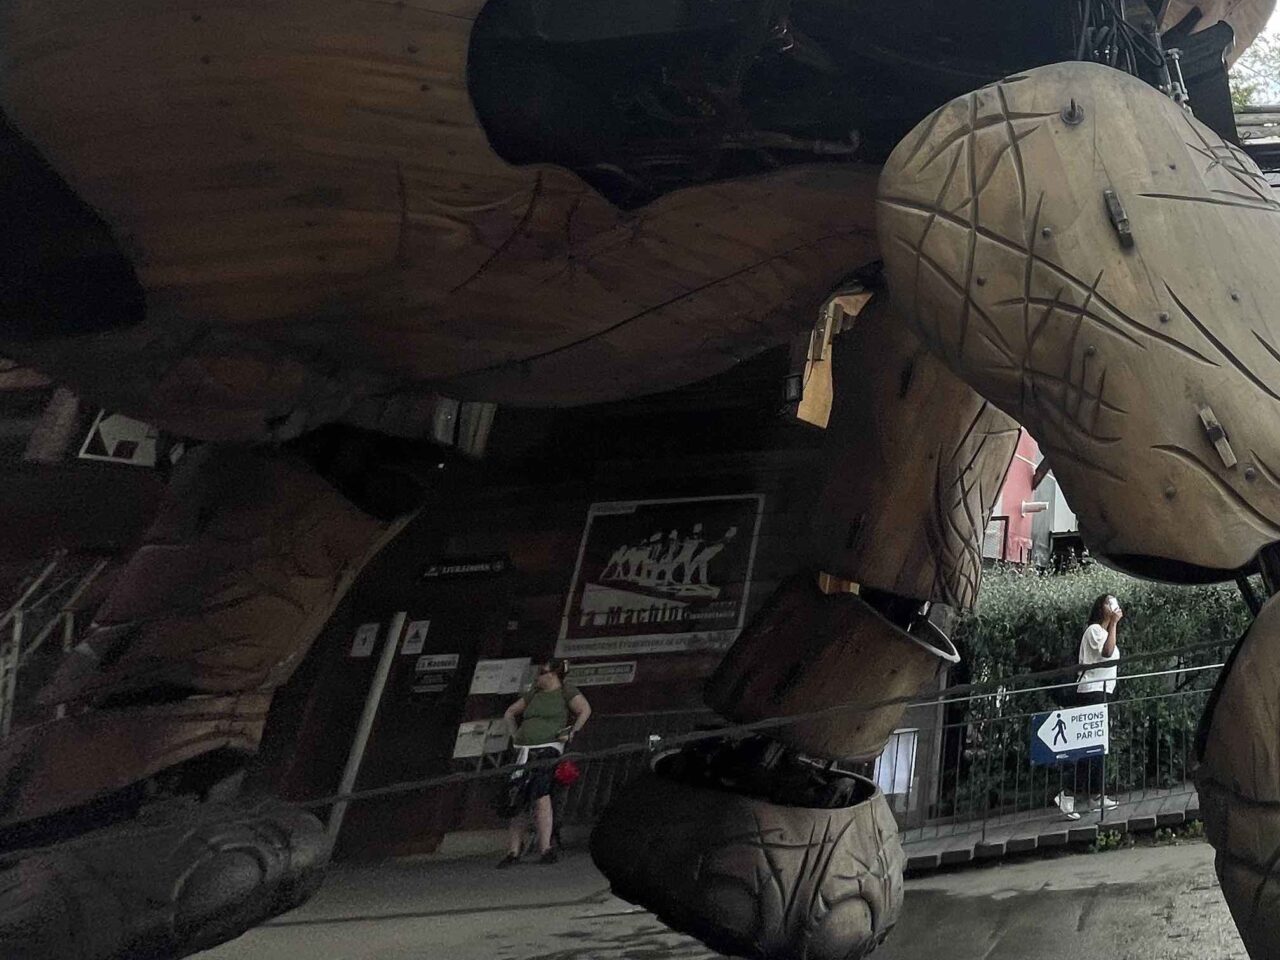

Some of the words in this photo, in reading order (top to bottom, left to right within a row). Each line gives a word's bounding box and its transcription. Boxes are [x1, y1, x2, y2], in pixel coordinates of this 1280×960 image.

[1071, 711, 1104, 723] PIÉTONS
[1082, 720, 1104, 730] C'EST
[1076, 731, 1093, 740] PAR
[1094, 729, 1104, 737] ICI
